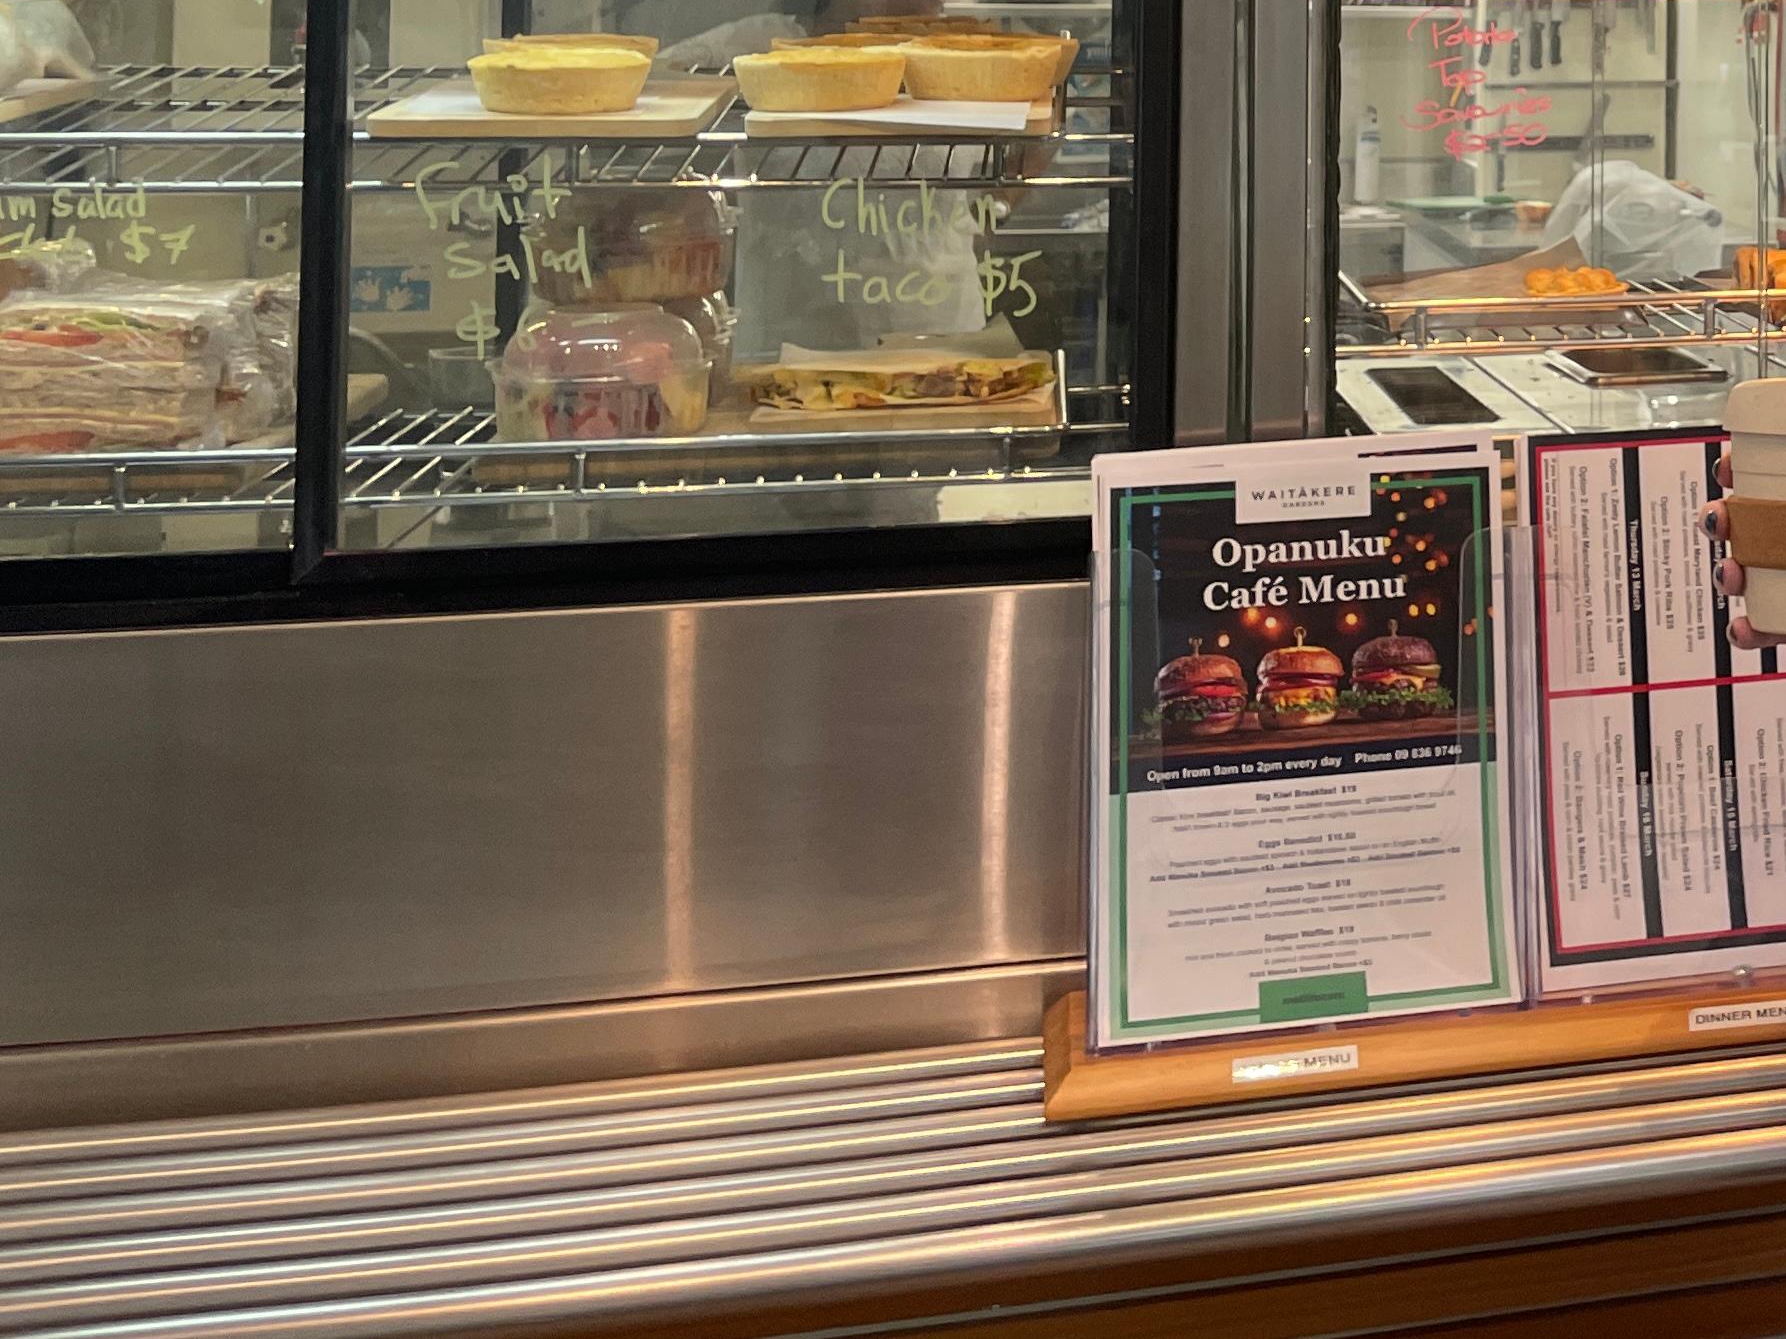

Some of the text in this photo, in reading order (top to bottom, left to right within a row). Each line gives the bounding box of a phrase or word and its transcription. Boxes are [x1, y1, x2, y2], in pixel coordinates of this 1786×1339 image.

[821, 177, 998, 236] Chicken
[821, 249, 1043, 318] taco $5
[1212, 529, 1388, 572] Opanuku
[1630, 519, 1639, 564] Thursday
[1203, 574, 1407, 611] Café Menu
[1147, 769, 1179, 783] Open
[1182, 767, 1210, 779] from
[1696, 1009, 1752, 1024] DINNER
